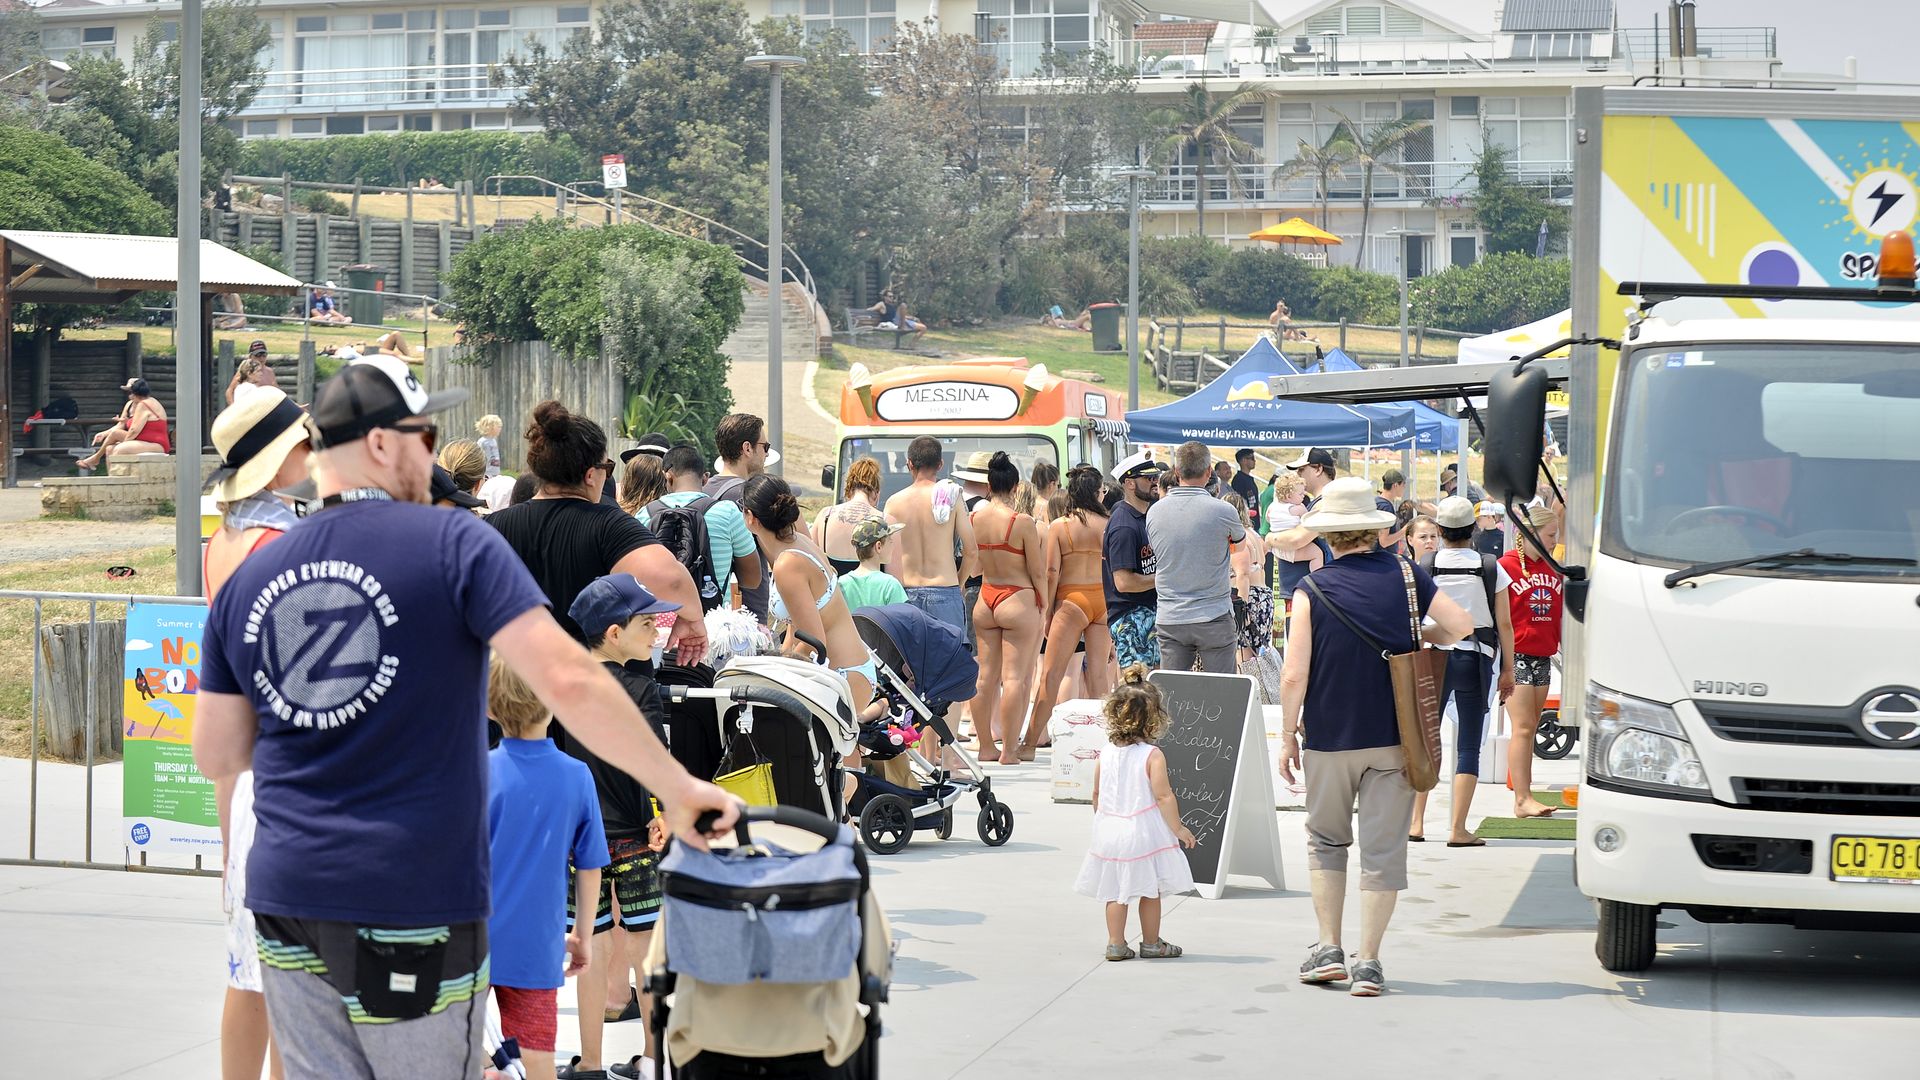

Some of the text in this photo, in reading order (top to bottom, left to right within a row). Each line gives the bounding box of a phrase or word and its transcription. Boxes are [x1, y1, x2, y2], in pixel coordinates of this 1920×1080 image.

[905, 388, 989, 402] MESSINA
[1211, 401, 1282, 411] WAVERLEY
[1181, 427, 1295, 440] waverley.nsw.gov.au
[300, 560, 364, 585] EYEWEAR
[361, 574, 382, 598] CO
[374, 593, 399, 627] USA
[156, 618, 193, 628] Summer
[253, 654, 400, 730] SITTING ON HAPPY FACES
[1693, 680, 1768, 696] HINO
[154, 762, 198, 773] THURSDAY 19
[154, 774, 168, 783] 10AM
[175, 775, 186, 784] 1PM
[188, 777, 206, 785] NORTH
[133, 826, 148, 836] FREE
[135, 834, 149, 843] EVENT
